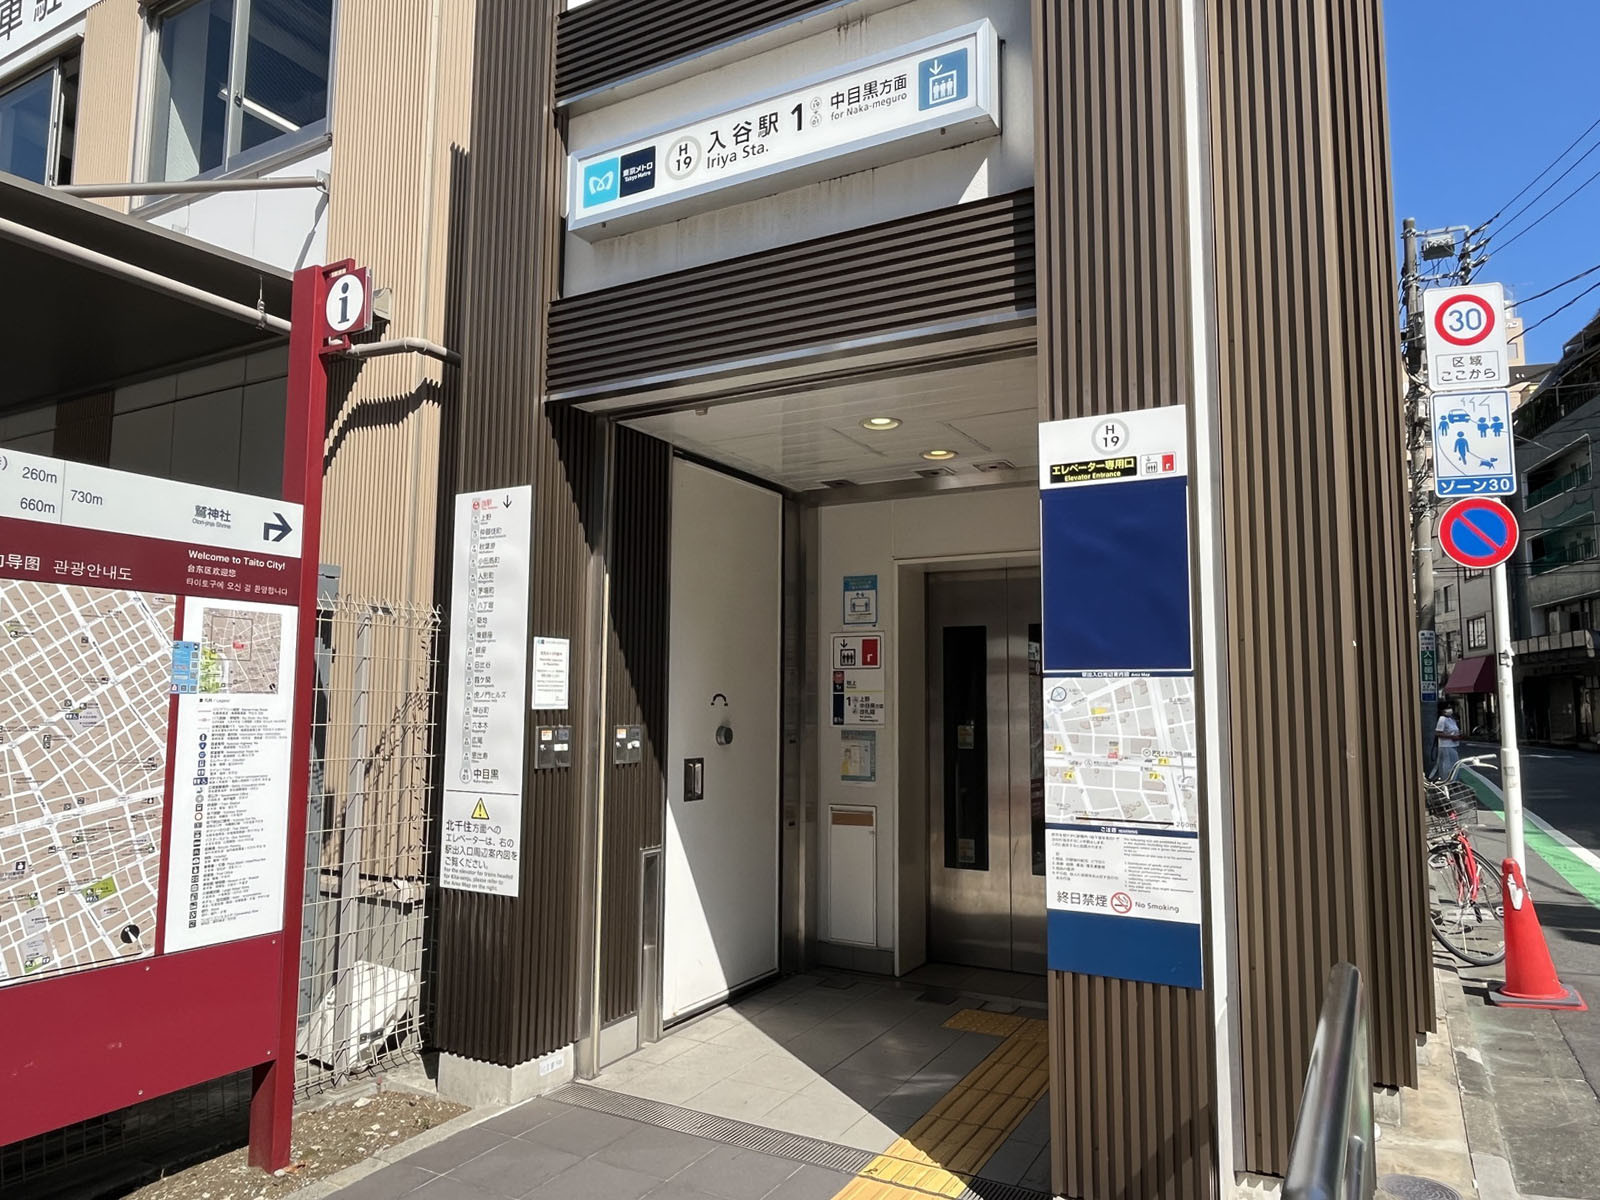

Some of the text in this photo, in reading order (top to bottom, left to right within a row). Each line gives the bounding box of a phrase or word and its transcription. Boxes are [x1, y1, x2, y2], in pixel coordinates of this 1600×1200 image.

[830, 74, 907, 109] 中目黒方面
[831, 92, 907, 120] for Naka-meguro
[790, 103, 803, 132] 1
[706, 112, 779, 154] 入谷駅
[679, 143, 688, 156] H
[706, 143, 769, 171] Iriya Sta.
[622, 161, 653, 177] 東京メトロ
[676, 156, 692, 171] 19
[625, 170, 651, 182] Tokyo Metro
[1448, 308, 1482, 332] 30
[1452, 355, 1482, 368] 区域
[1441, 368, 1496, 382] ここから
[1105, 424, 1115, 435] H
[1103, 435, 1119, 448] 19
[1052, 458, 1134, 475] エレベーター専用口
[22, 466, 58, 484] 260m
[1064, 470, 1121, 482] Elevator Entrance
[1440, 477, 1510, 493] ゾーン30
[20, 497, 55, 514] 660m
[70, 489, 103, 506] 730m
[188, 550, 286, 571] Welcome to Taito City!
[53, 560, 133, 581] 관광안내도
[187, 564, 237, 577] 台东区欢迎您
[227, 581, 241, 592] 오신
[254, 585, 288, 595] 환영합니다
[473, 768, 499, 780] 中目黒
[446, 819, 502, 835] 北千住方面への
[445, 844, 518, 861] 駅出入口周辺案内図を
[445, 856, 488, 870] ご覧ください。
[1057, 890, 1108, 908] 終日禁煙
[1148, 902, 1180, 913] Smoking
